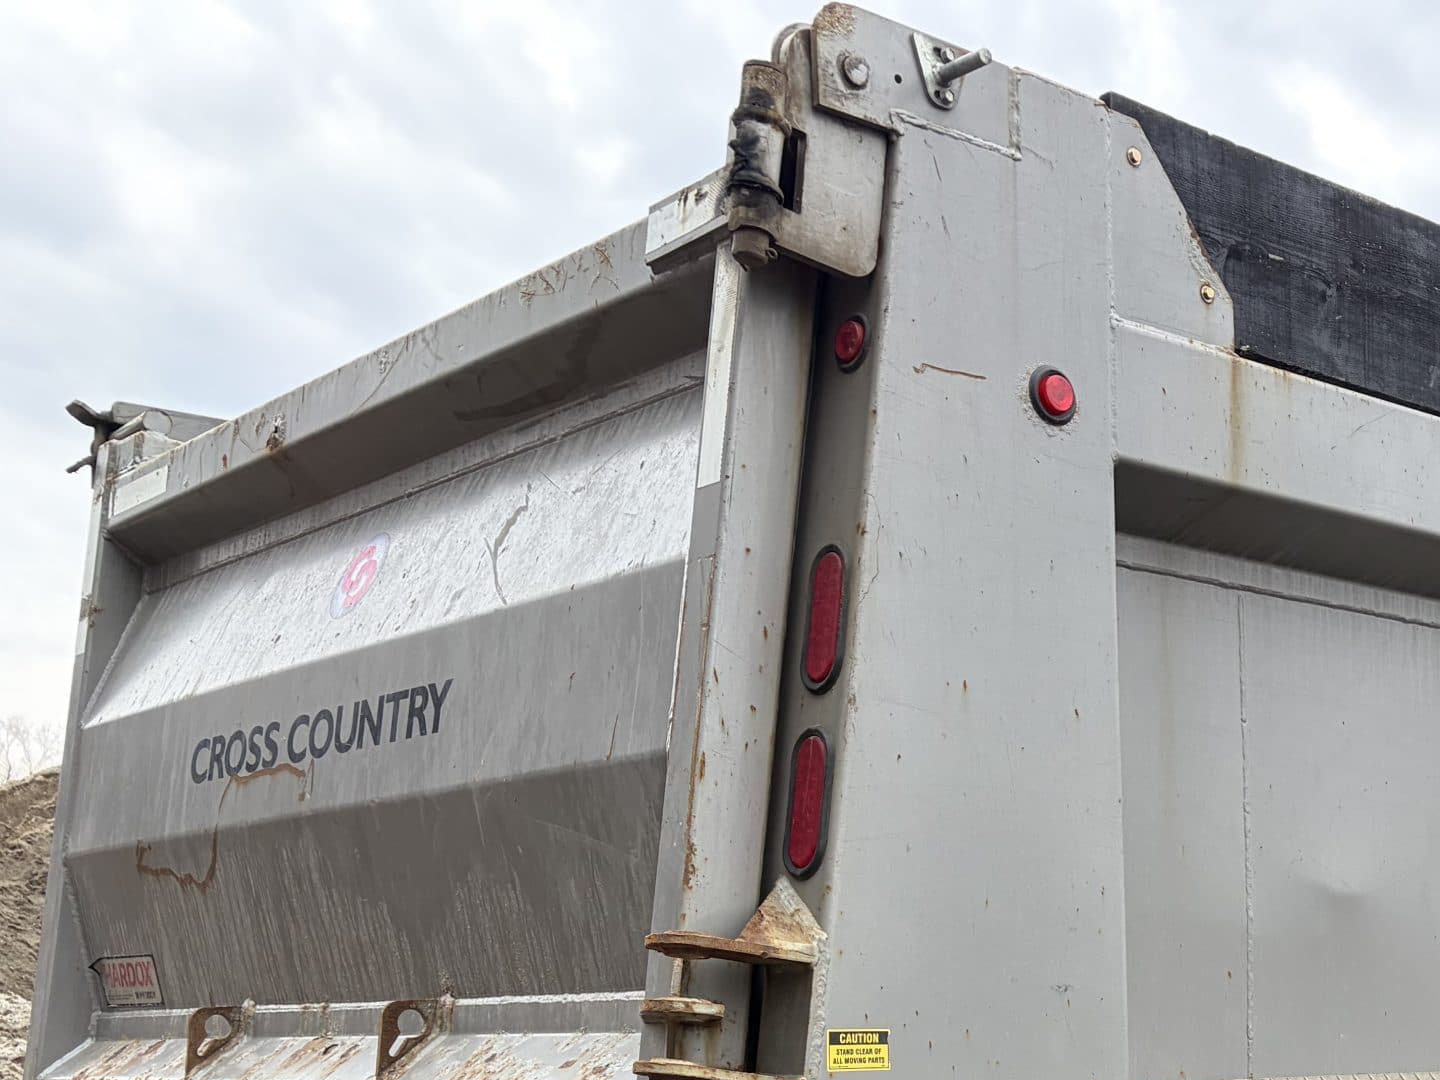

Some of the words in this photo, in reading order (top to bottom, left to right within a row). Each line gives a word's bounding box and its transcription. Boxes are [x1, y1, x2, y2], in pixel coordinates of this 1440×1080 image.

[191, 721, 281, 785] CROSS
[287, 678, 455, 764] COUNTRY
[840, 1033, 880, 1044] CAUTION
[836, 1048, 854, 1056] STAND
[855, 1047, 873, 1055] CLEAR
[874, 1047, 882, 1055] OF
[832, 1057, 843, 1065] ALL
[867, 1056, 885, 1064] PARTS
